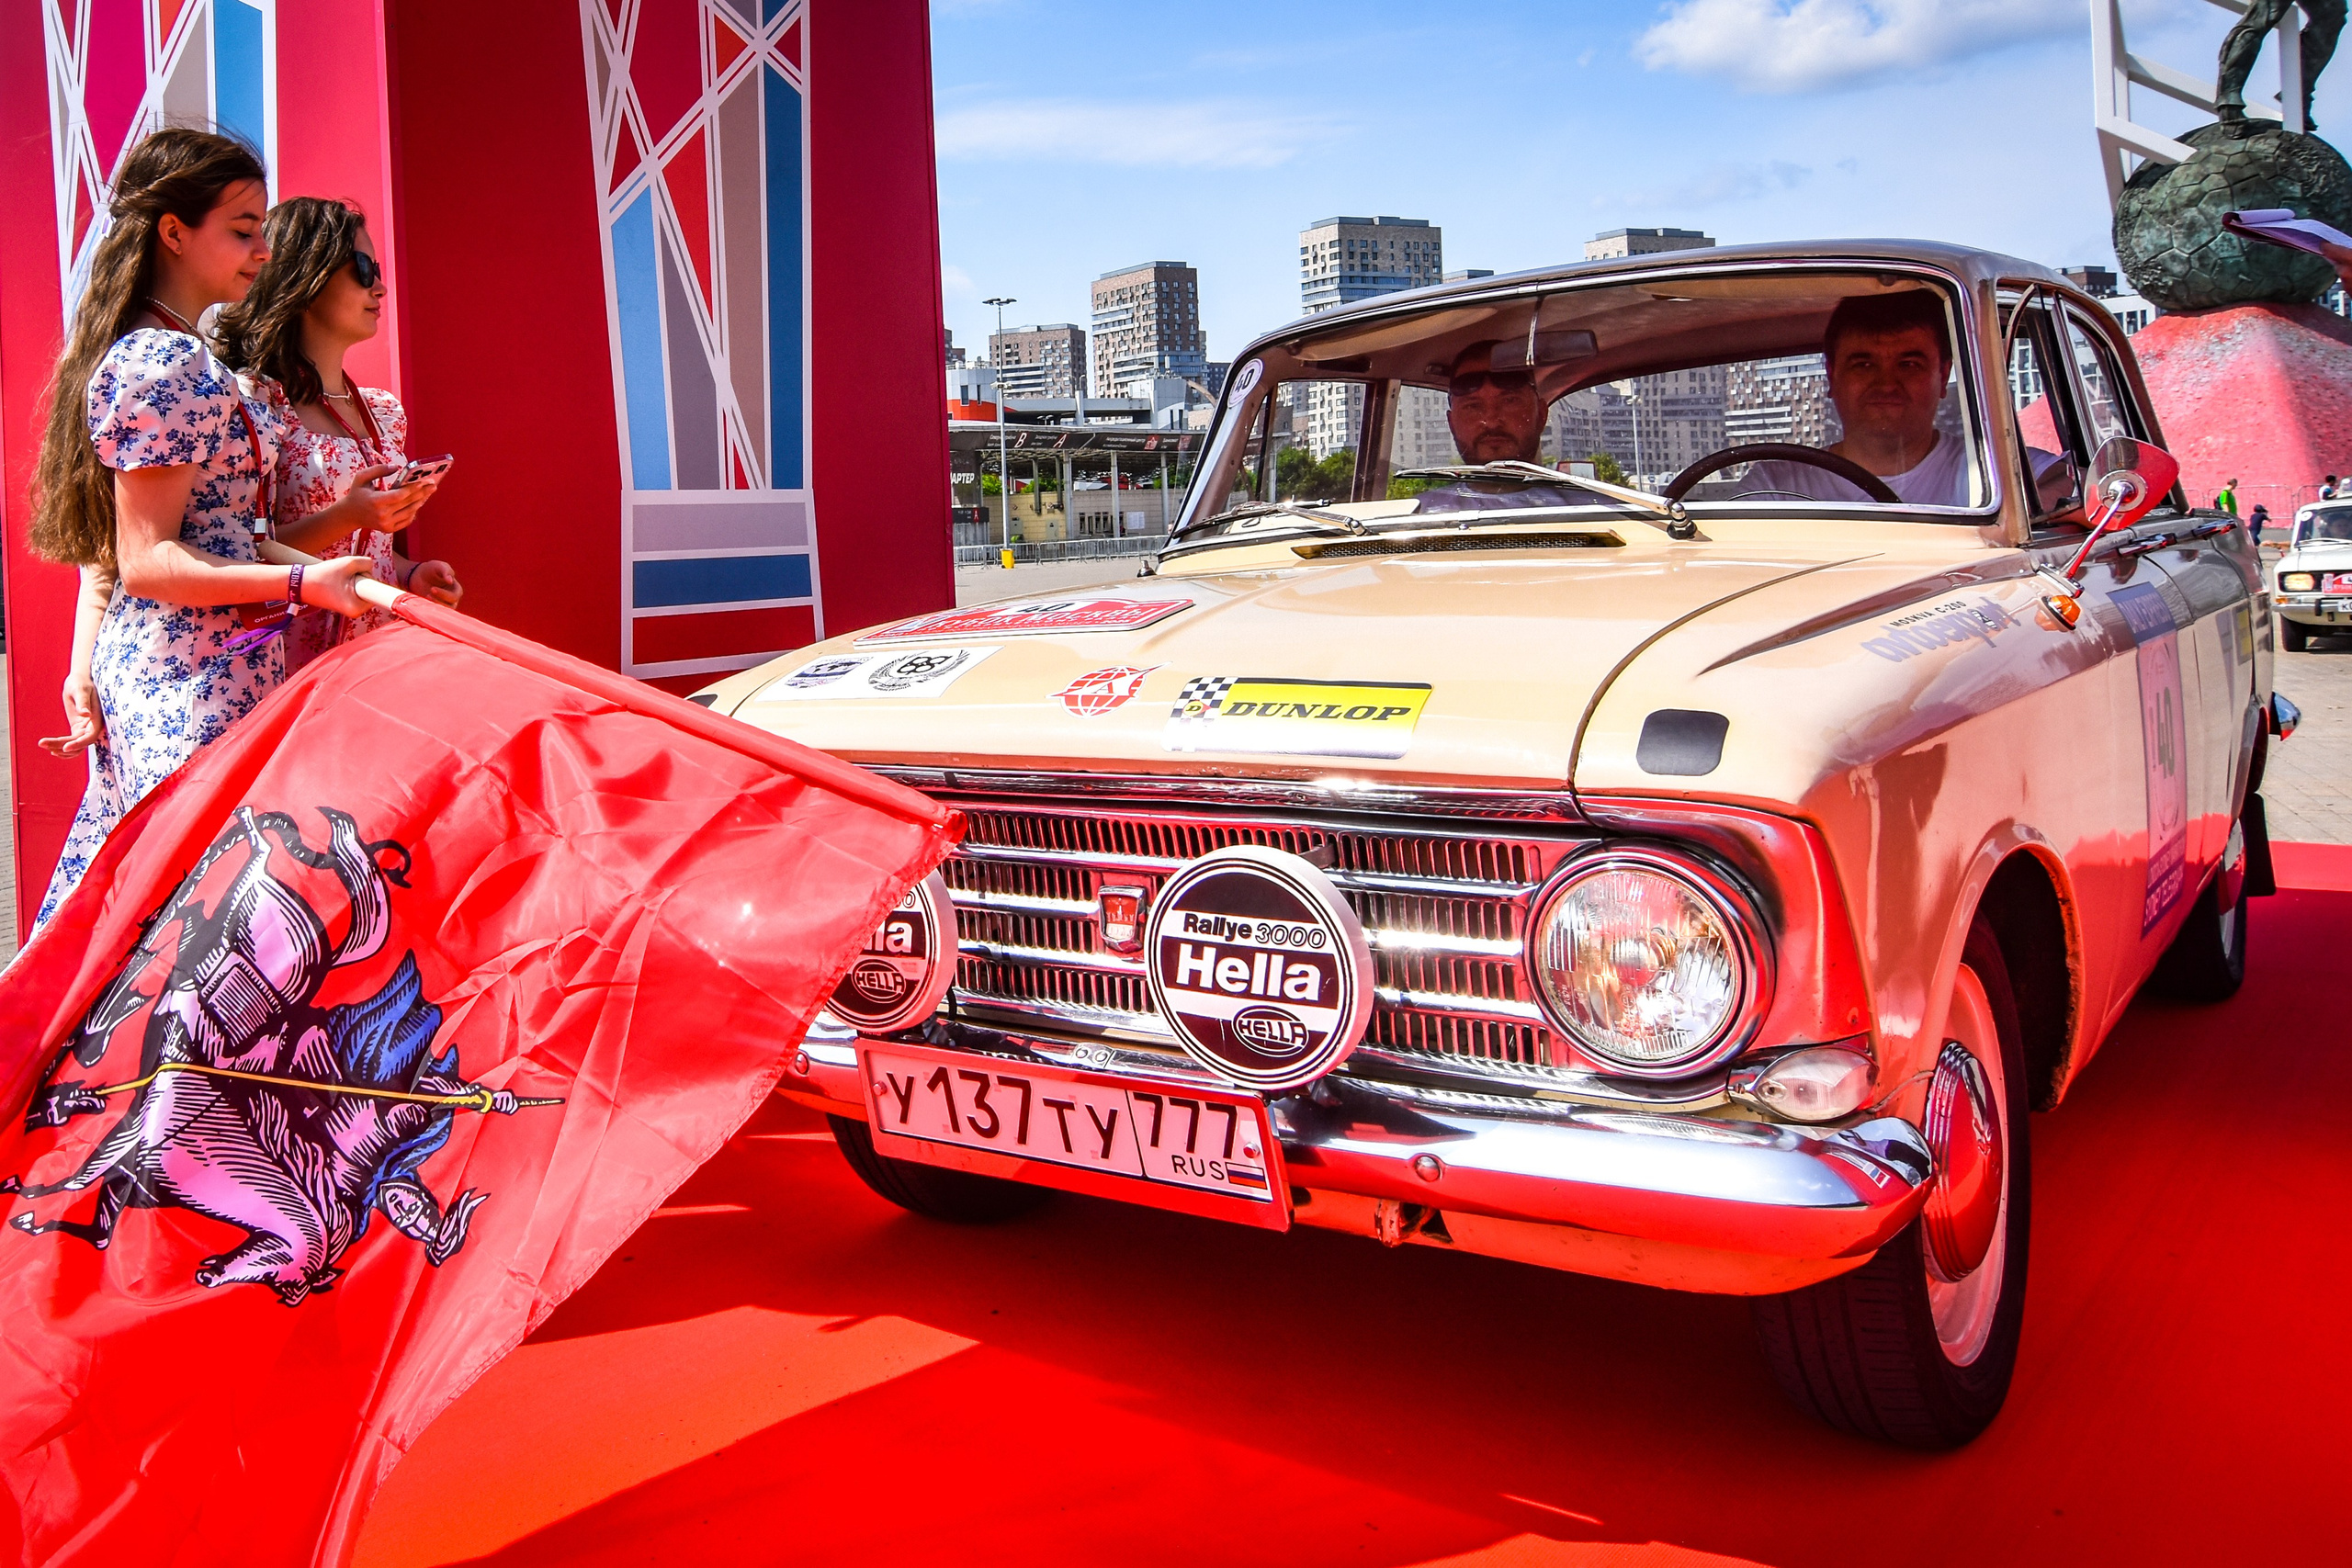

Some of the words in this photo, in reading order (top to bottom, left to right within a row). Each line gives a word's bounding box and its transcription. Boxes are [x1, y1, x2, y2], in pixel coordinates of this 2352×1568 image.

[1235, 368, 1255, 392] 40
[931, 615, 1020, 628] КУБОК
[1021, 607, 1159, 622] МОСКВЫ
[1015, 603, 1076, 613] 40
[1889, 611, 1936, 627] MOSKVA
[1934, 601, 1968, 614] C-200
[1221, 702, 1411, 721] DUNLOP
[1182, 912, 1251, 942] Rallye
[1254, 922, 1328, 950] 3000
[855, 971, 905, 994] HELLA
[1175, 942, 1322, 1001] Hella
[1238, 1017, 1306, 1046] HELLA
[1134, 1091, 1238, 1160] 777
[1170, 1154, 1226, 1181] RUS
